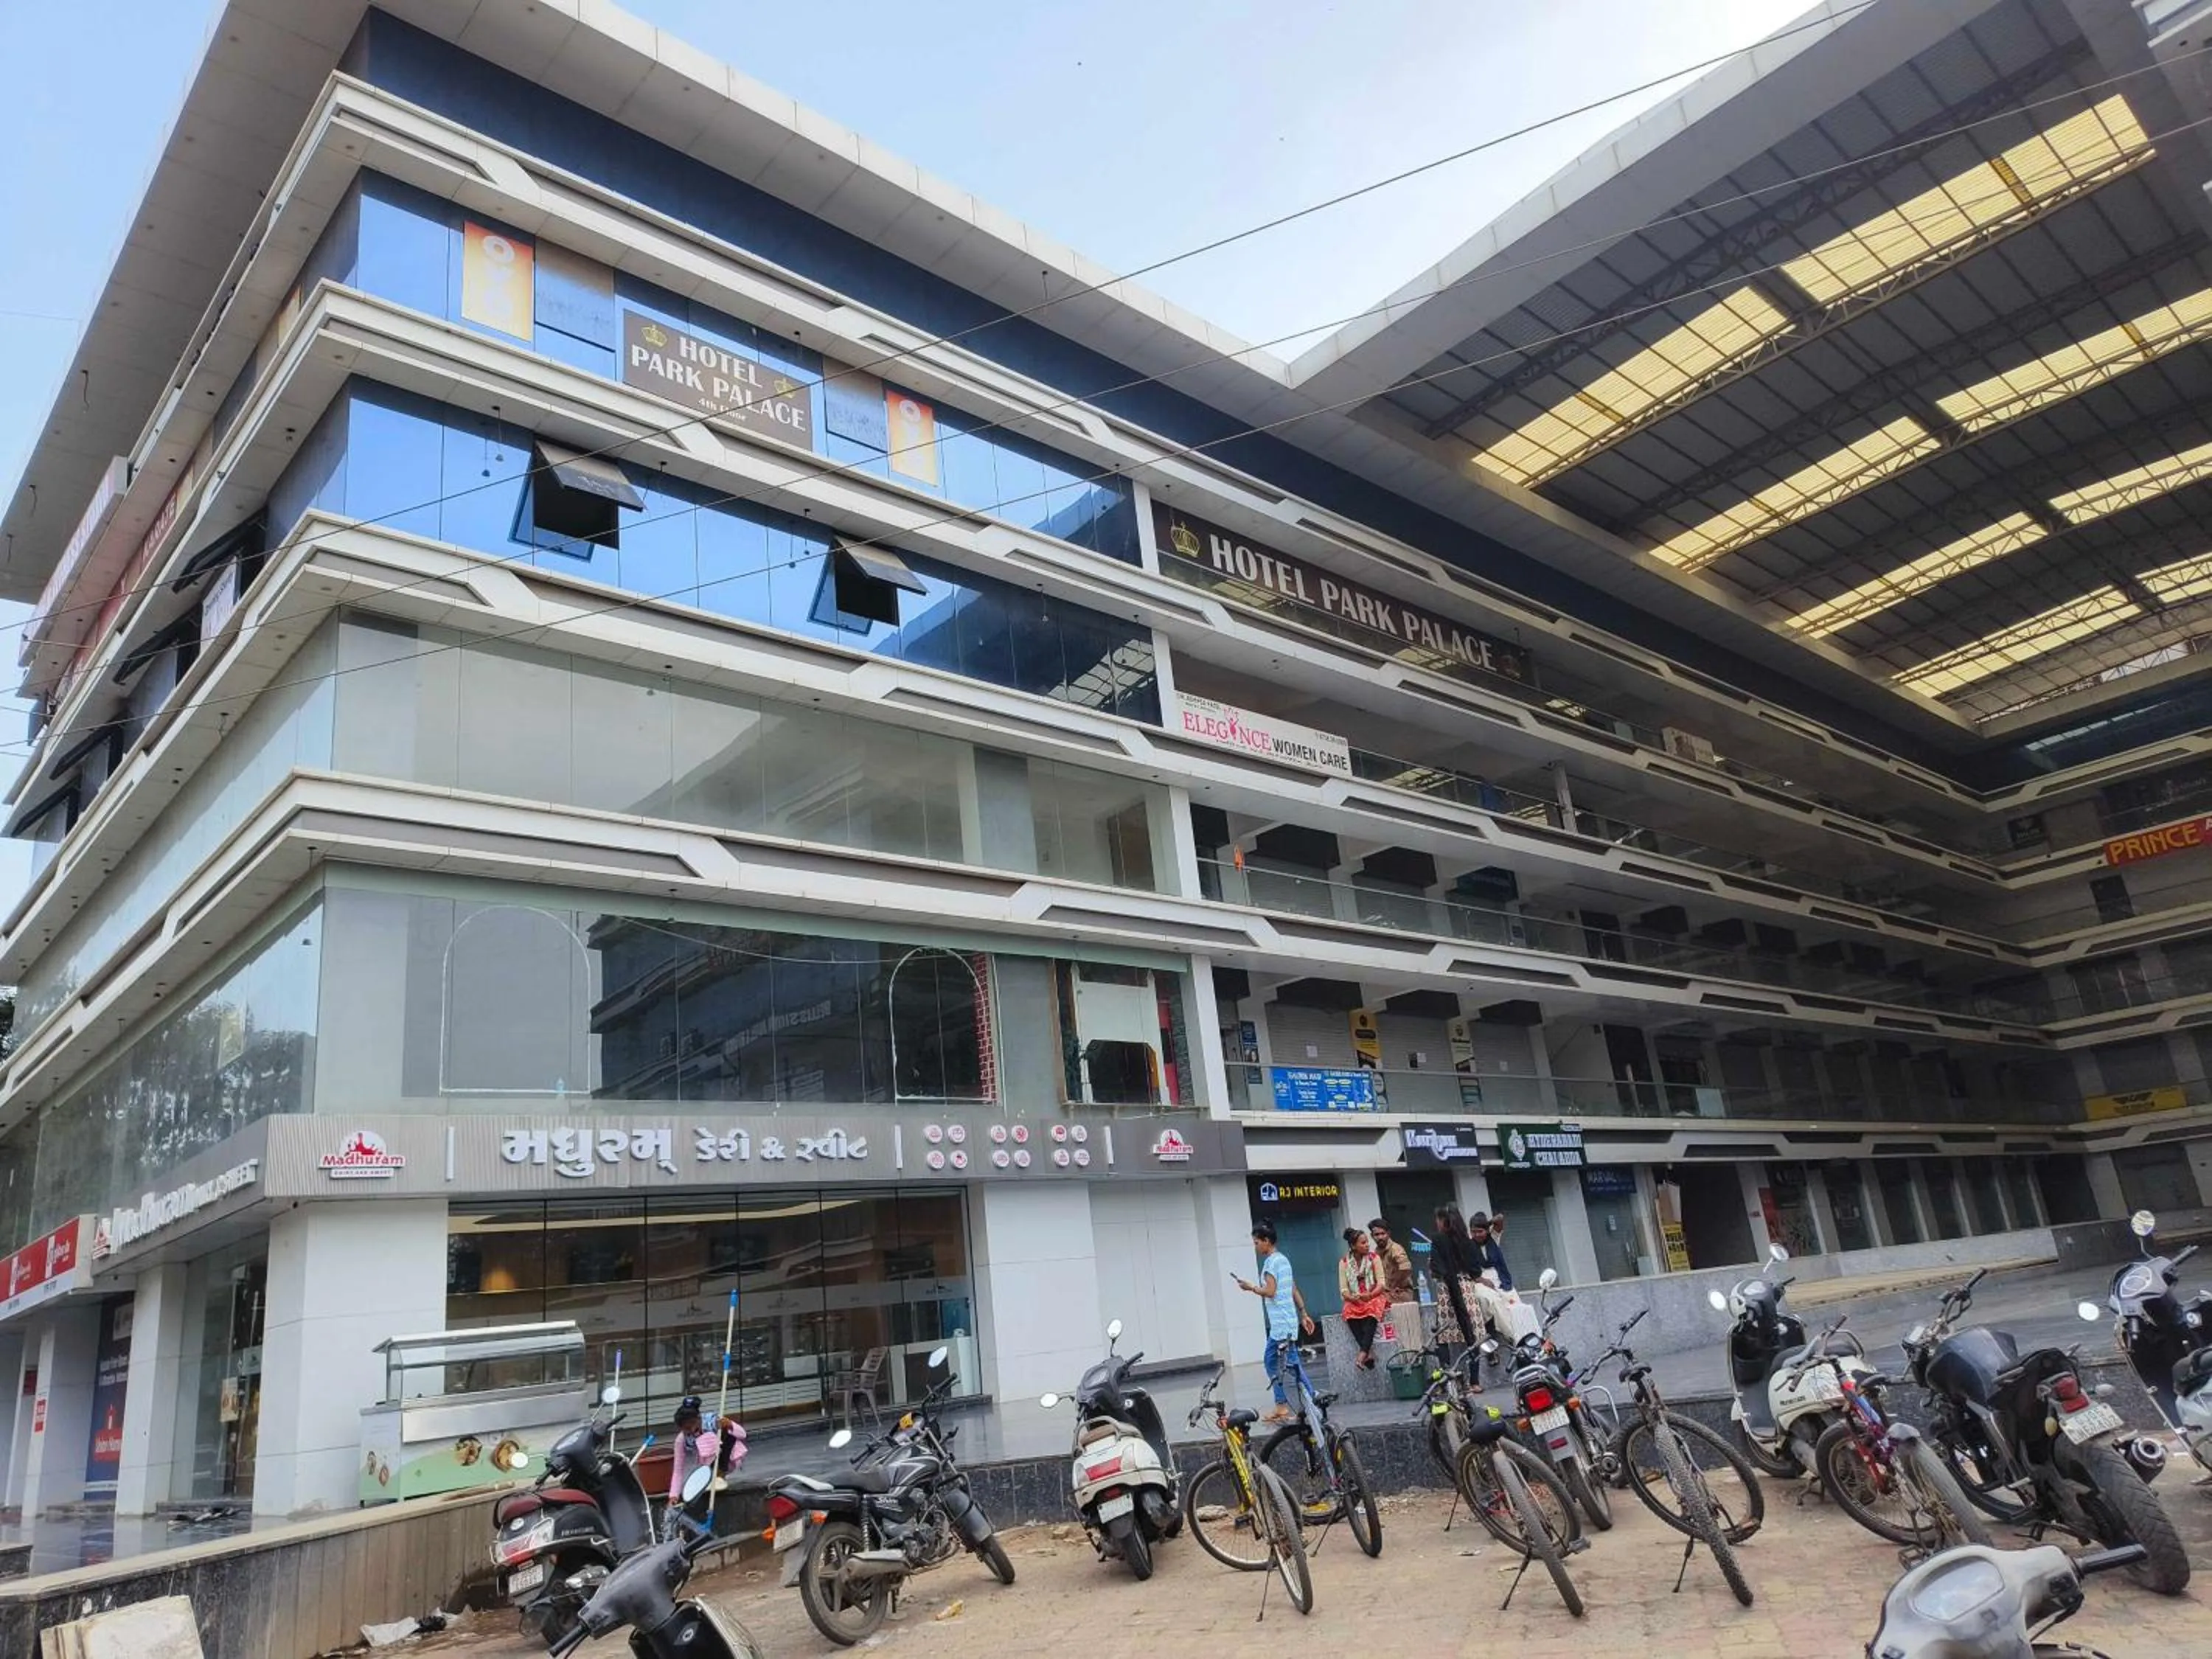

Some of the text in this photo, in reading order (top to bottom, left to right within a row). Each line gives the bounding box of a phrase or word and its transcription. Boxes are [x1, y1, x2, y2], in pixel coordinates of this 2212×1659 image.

[678, 336, 763, 389] HOTEL
[631, 344, 807, 432] PARK PALACE
[1209, 533, 1498, 672] HOTEL PARK PALACE
[1272, 737, 1317, 762] WOMEN
[1319, 749, 1349, 771] CARE
[2109, 822, 2201, 863] PRINCE
[322, 1152, 404, 1165] Madhuram
[1294, 1185, 1338, 1198] INTERIOR
